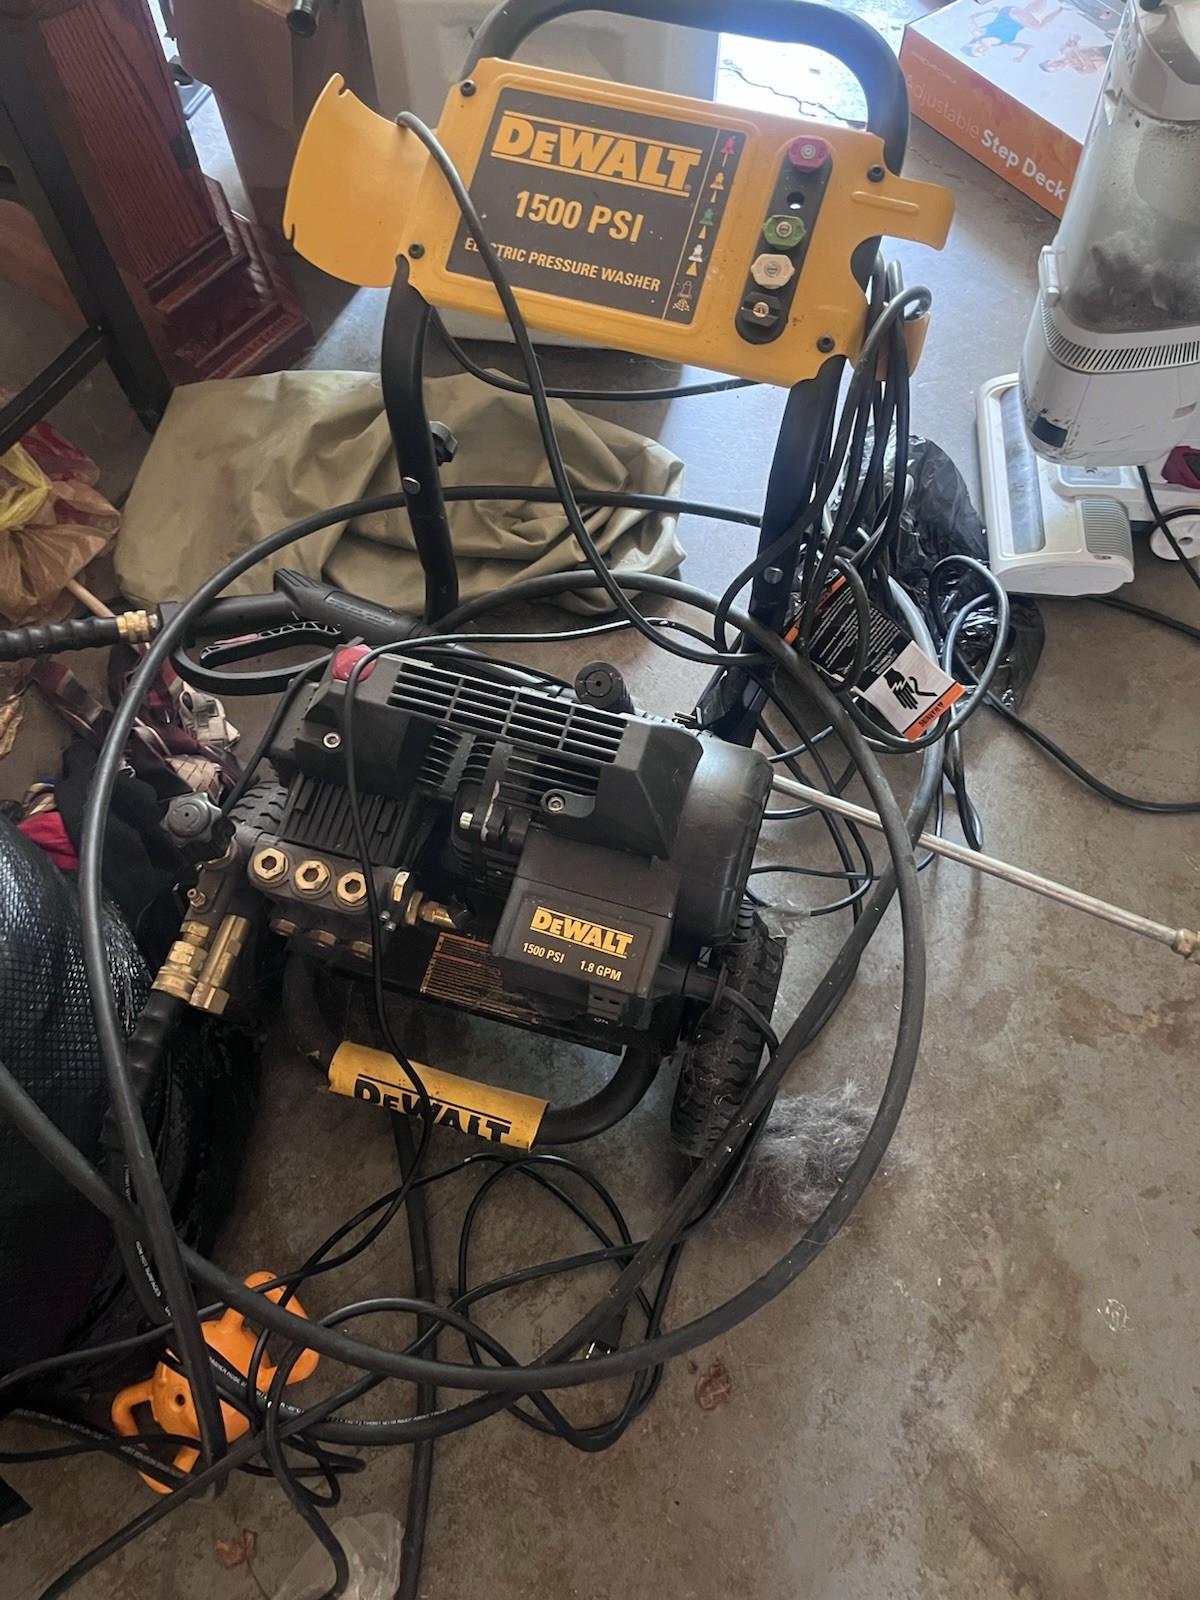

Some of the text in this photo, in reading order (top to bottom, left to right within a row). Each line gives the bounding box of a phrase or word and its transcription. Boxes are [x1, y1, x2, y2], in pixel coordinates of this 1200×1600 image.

[491, 115, 701, 191] DEWALT
[981, 129, 1019, 168] Step
[1021, 157, 1067, 200] Deck
[516, 190, 644, 243] 1500 PSI
[464, 237, 661, 292] ELTRIC PRESSURE WASHER
[530, 908, 633, 955] DEWALT
[523, 942, 622, 981] 1500 PSI 1.8 GPM
